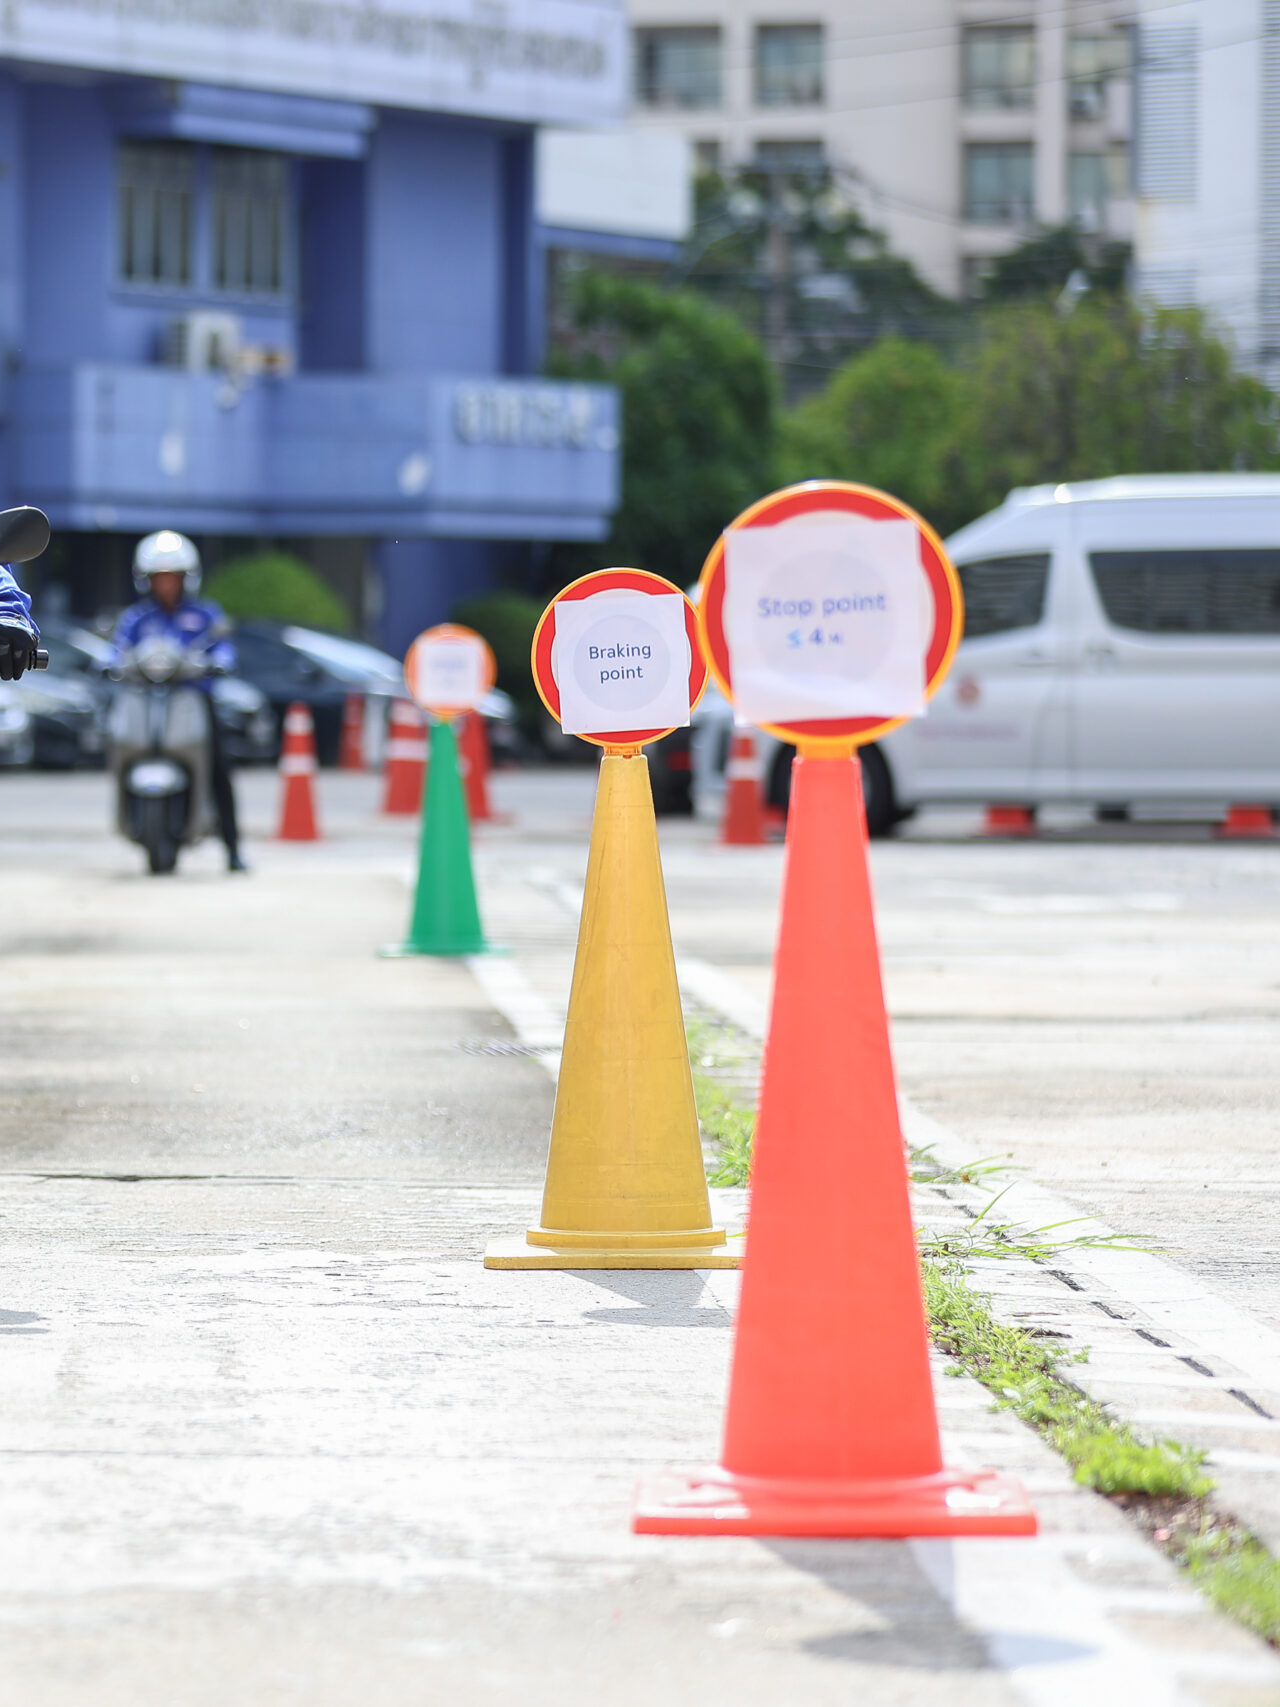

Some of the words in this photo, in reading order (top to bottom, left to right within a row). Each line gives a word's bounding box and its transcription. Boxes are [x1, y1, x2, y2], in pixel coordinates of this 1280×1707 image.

[758, 597, 812, 619] Stop
[822, 592, 886, 618] point
[589, 643, 651, 659] Braking
[600, 666, 644, 684] point
